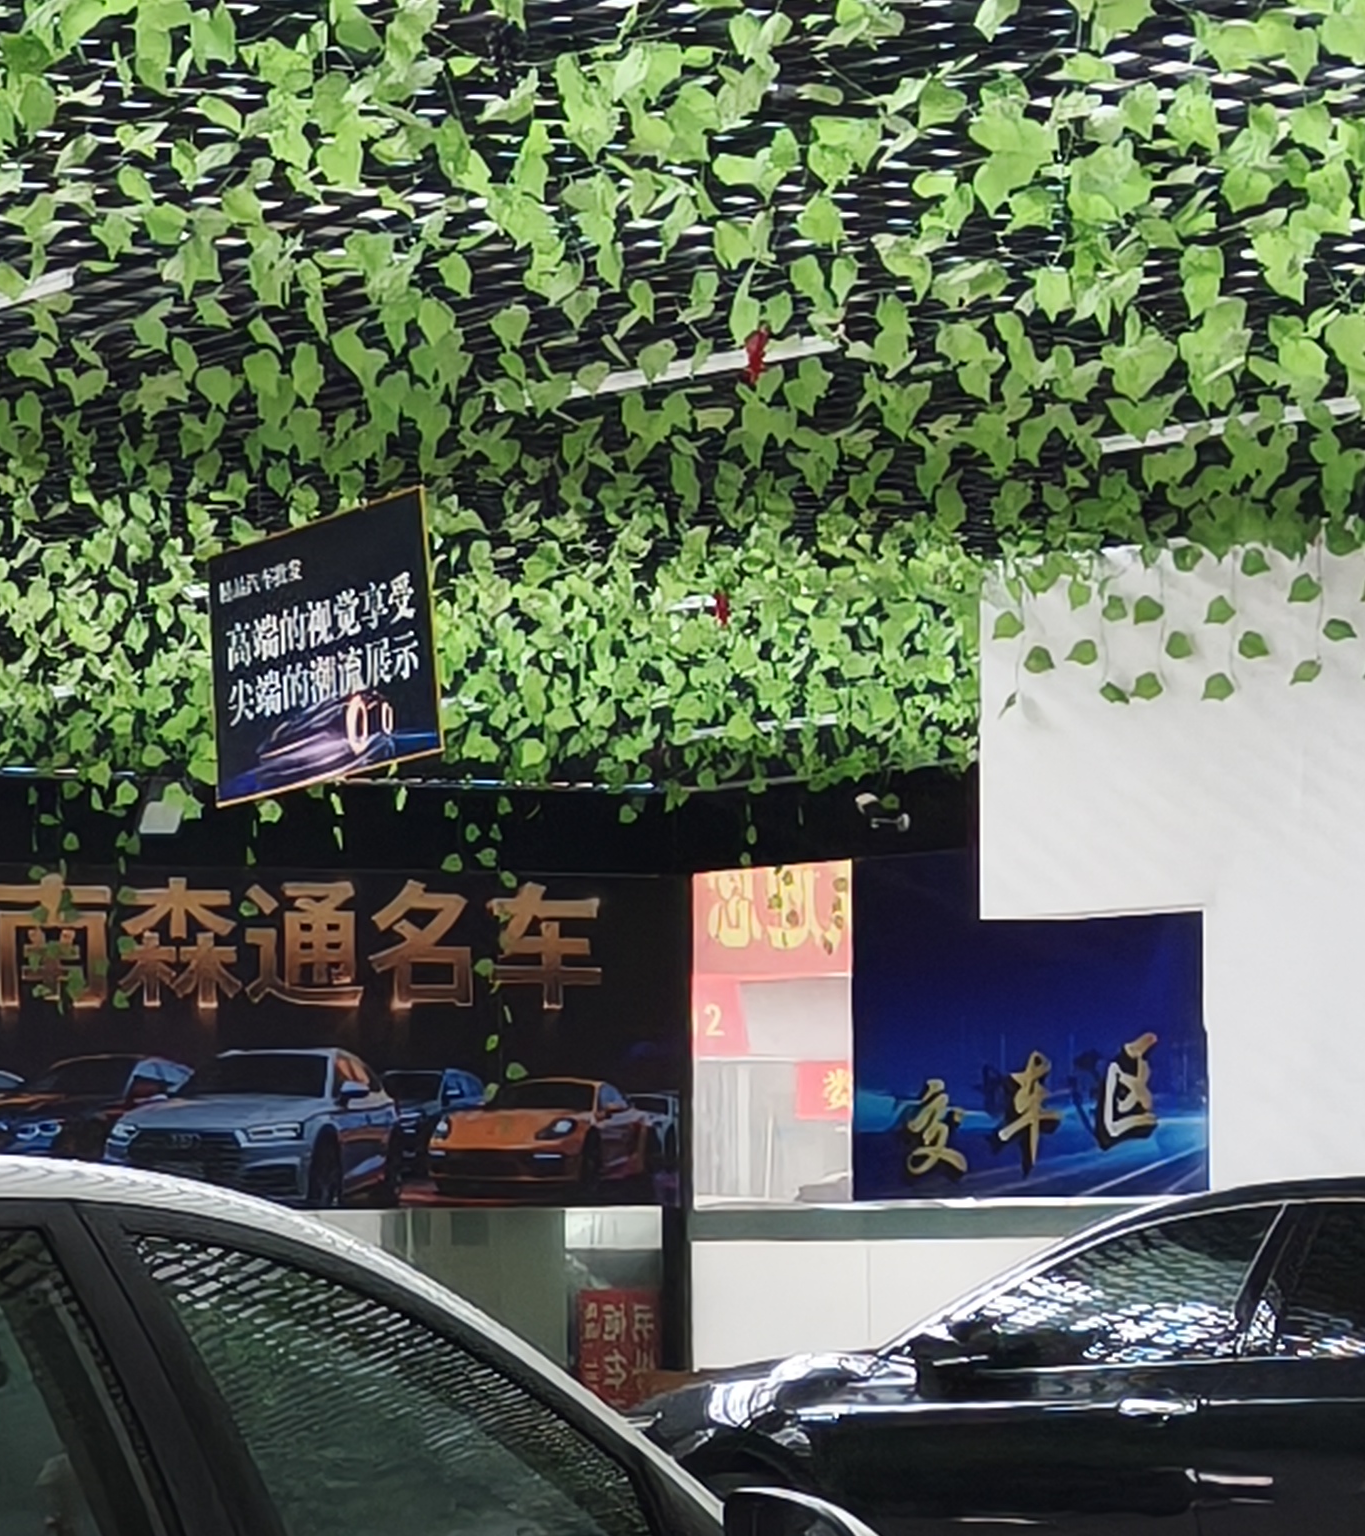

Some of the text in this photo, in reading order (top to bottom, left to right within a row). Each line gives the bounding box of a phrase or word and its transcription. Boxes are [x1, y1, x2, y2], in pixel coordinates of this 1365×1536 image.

[225, 571, 417, 672] 高端的视觉享受
[227, 630, 420, 727] 尖端的潮流展示
[906, 1032, 1158, 1174] 交车区
